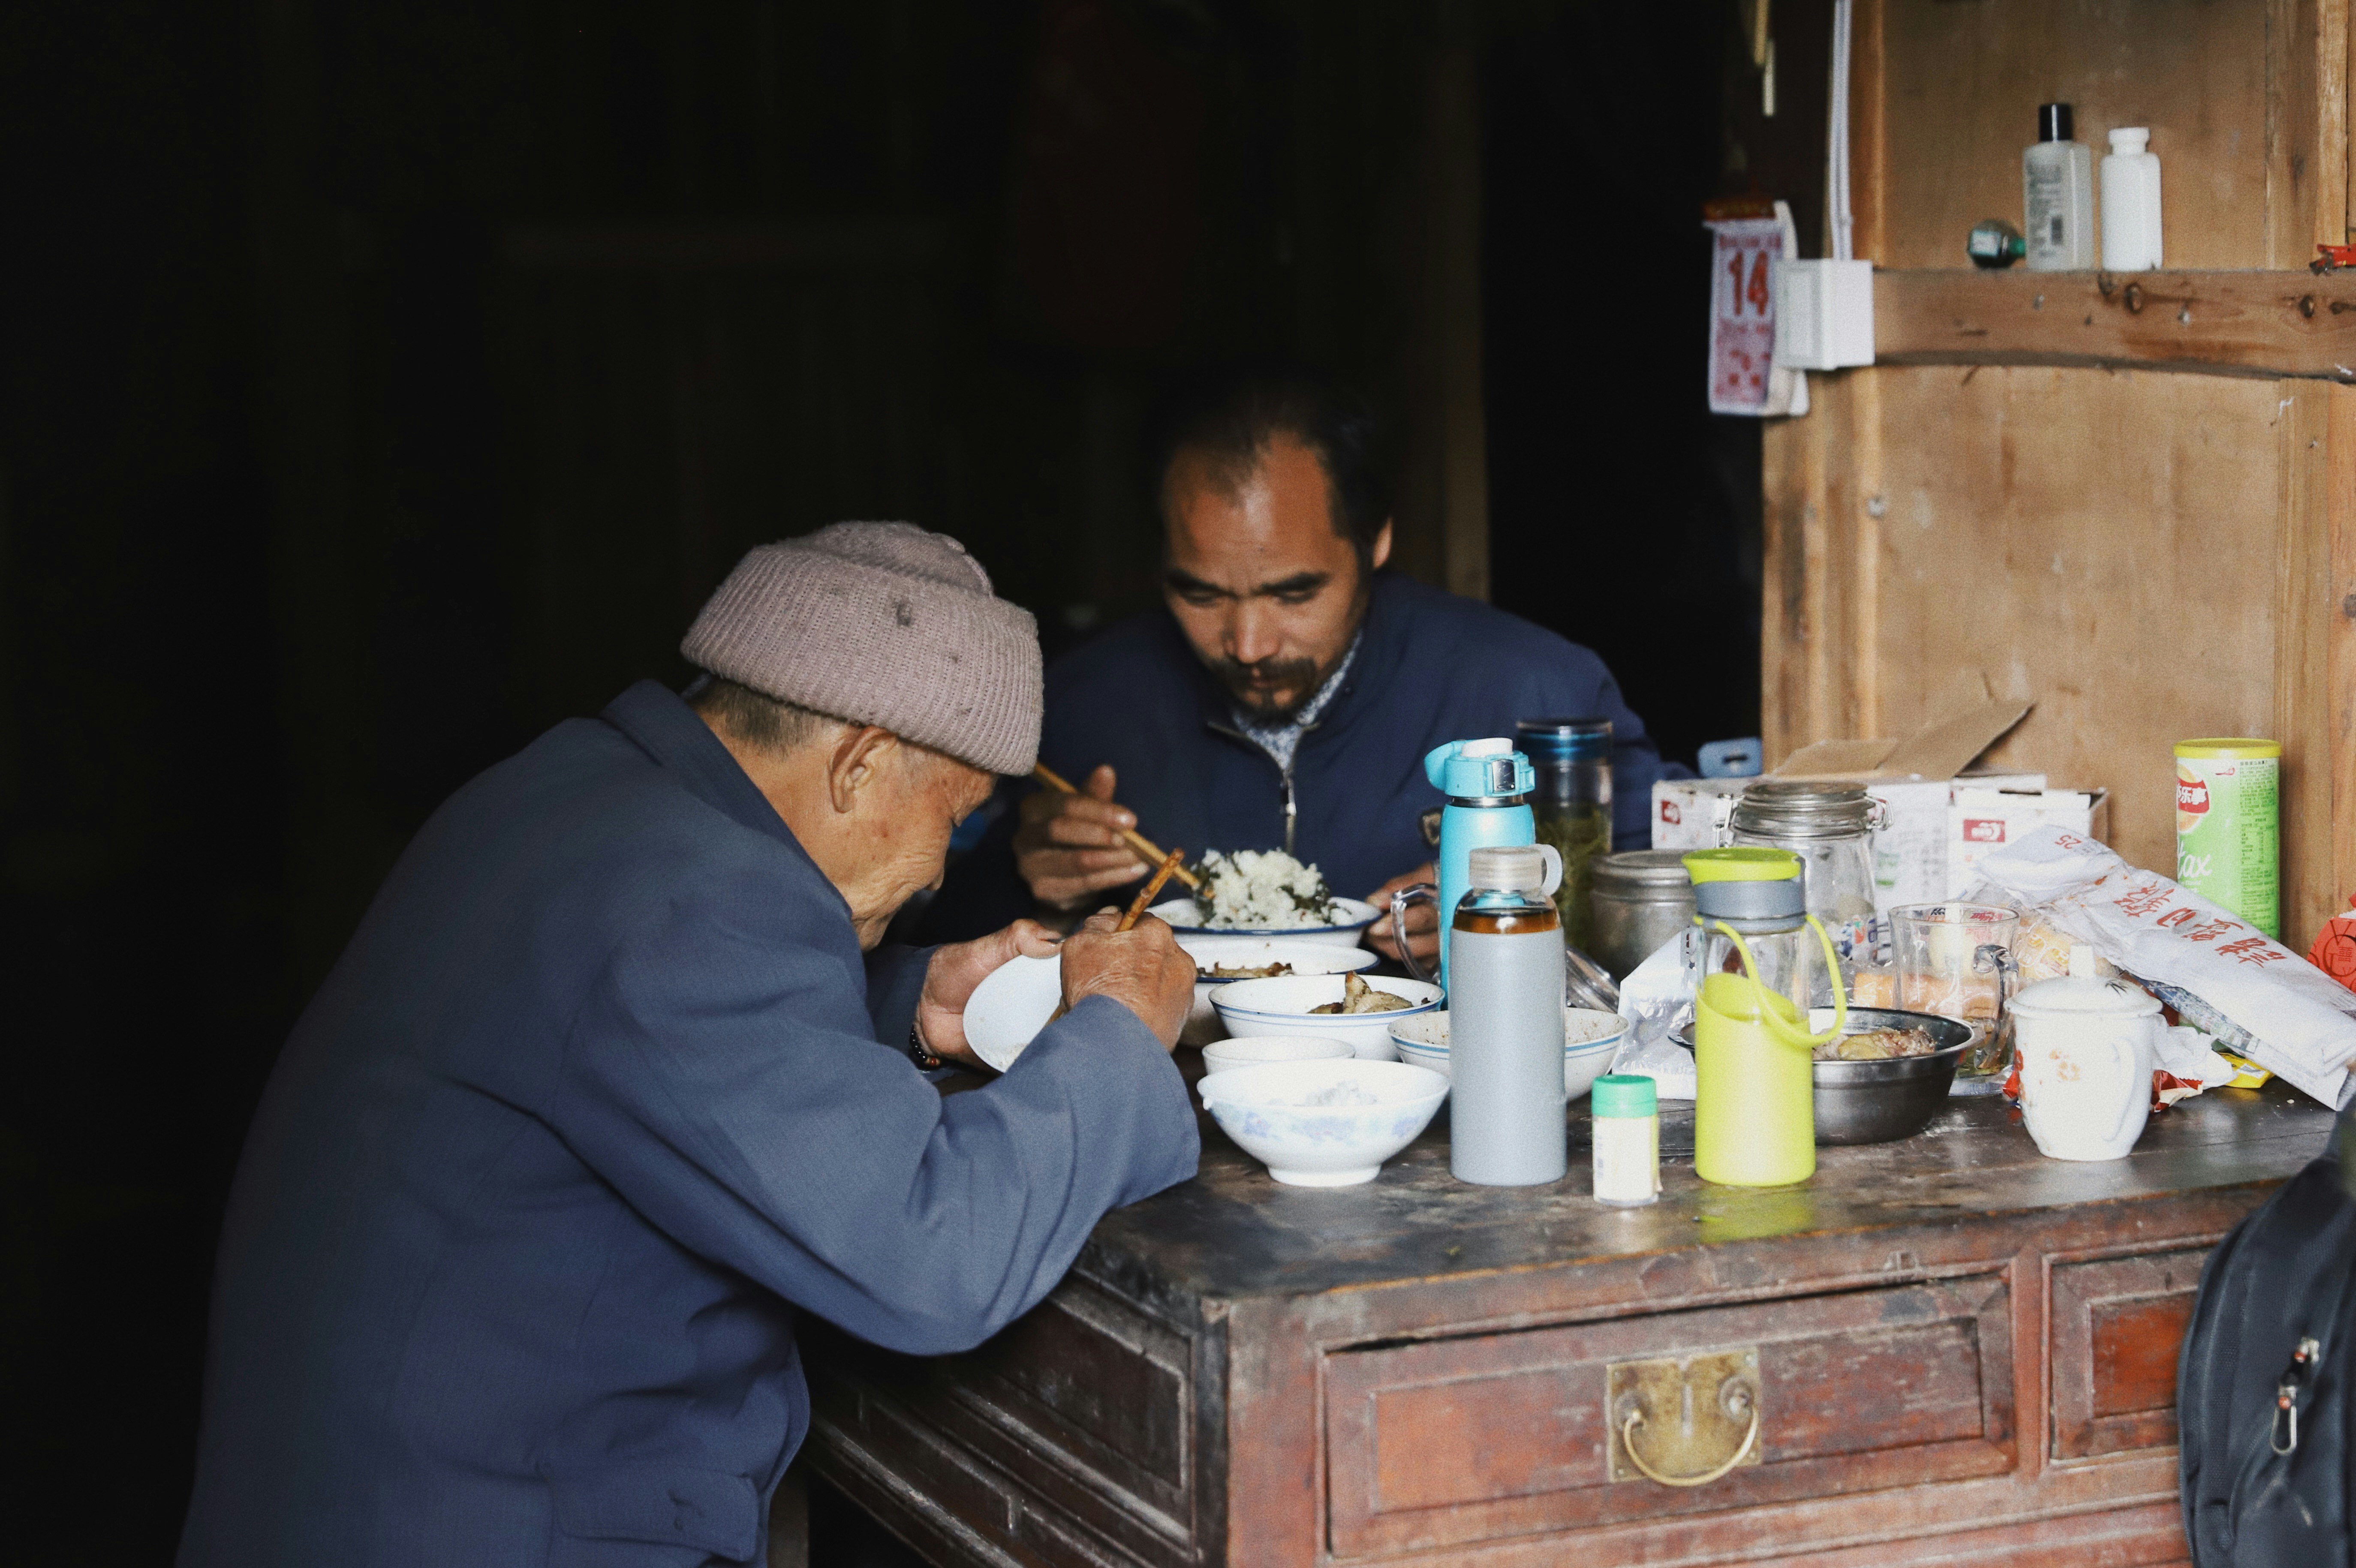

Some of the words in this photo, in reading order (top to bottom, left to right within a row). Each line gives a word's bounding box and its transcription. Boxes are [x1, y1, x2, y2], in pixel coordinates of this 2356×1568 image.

[1727, 249, 1769, 316] 14
[2180, 786, 2207, 805] 乐事
[2055, 834, 2082, 850] 25
